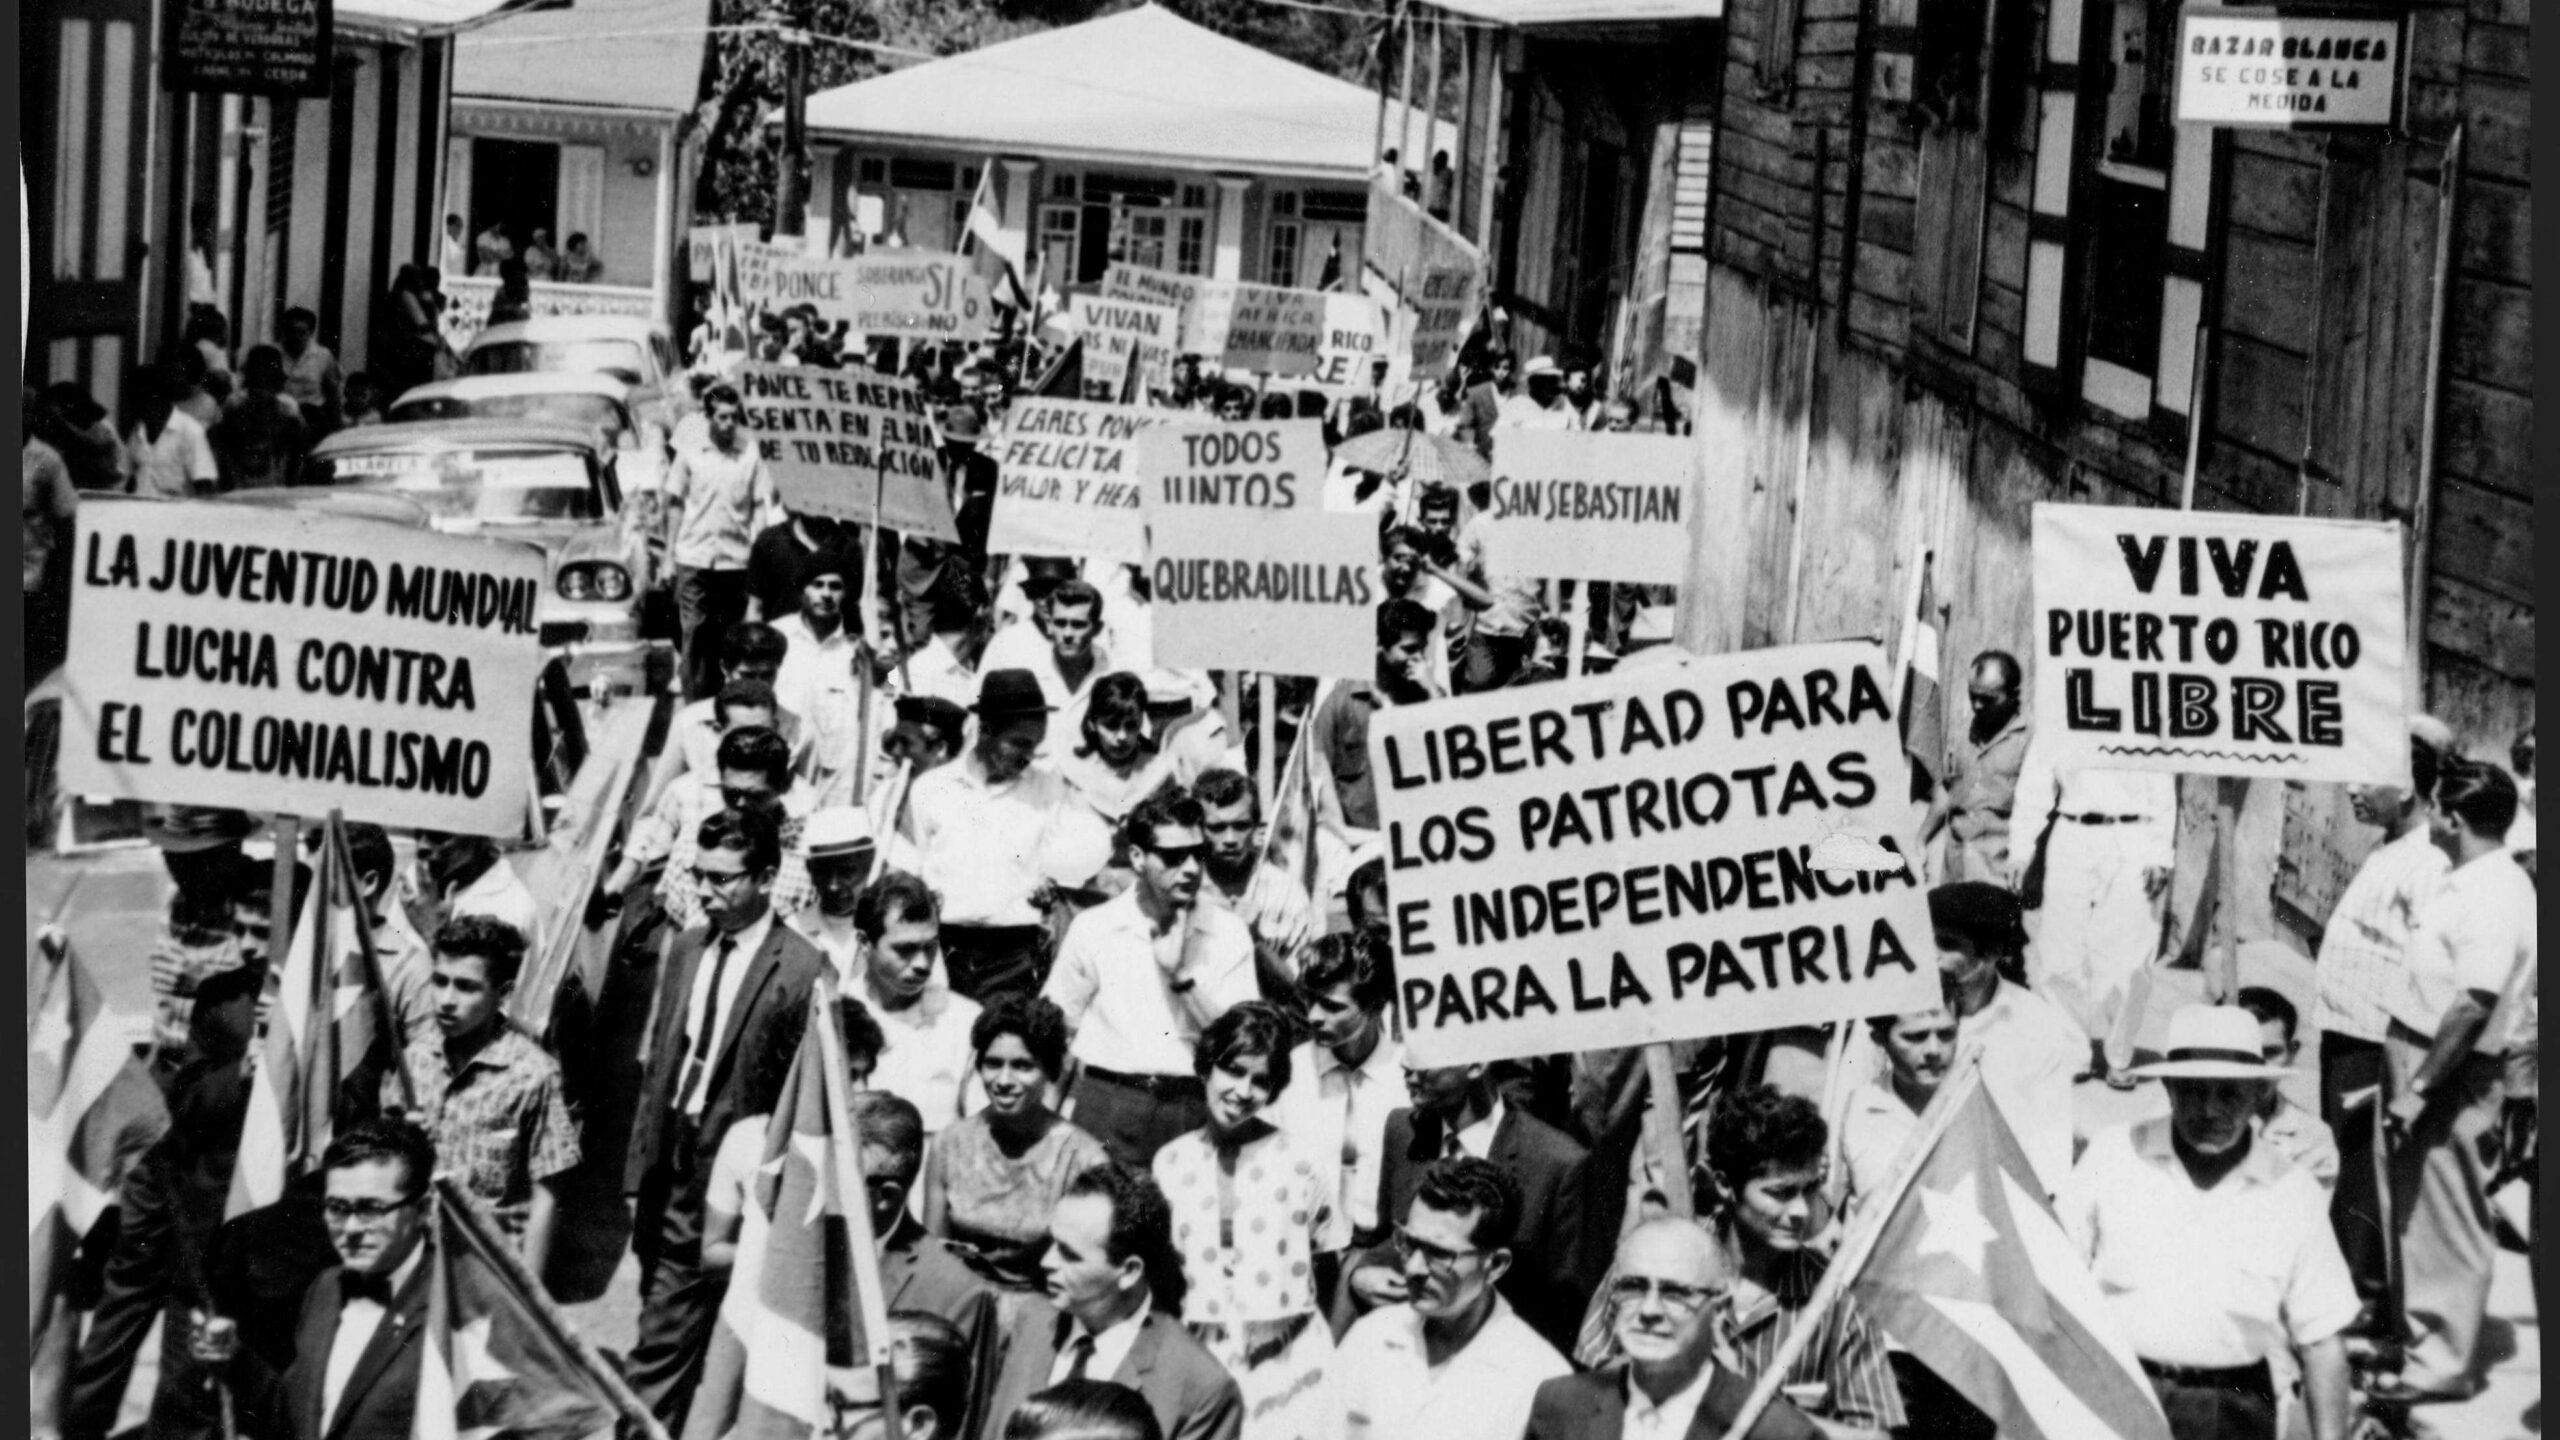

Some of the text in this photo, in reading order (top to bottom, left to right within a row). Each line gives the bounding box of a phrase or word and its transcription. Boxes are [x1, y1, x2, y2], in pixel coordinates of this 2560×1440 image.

[2191, 35, 2387, 61] BAZAR BLANCA
[2202, 66, 2359, 89] SE COSE A LA
[2249, 93, 2326, 113] MEDIDA
[775, 270, 841, 299] PONCE
[922, 262, 953, 311] SI
[1247, 289, 1304, 309] VIVA
[928, 313, 957, 332] NO
[1085, 303, 1161, 337] VIVAN
[1237, 307, 1315, 335] AFRICA
[1331, 330, 1372, 352] RICO
[744, 372, 811, 400] PONCE
[818, 378, 852, 404] TE
[747, 407, 834, 434] SENTA
[840, 411, 869, 438] EN
[1017, 407, 1090, 438] LARES
[758, 439, 782, 461] DE
[792, 440, 821, 464] TU
[1004, 439, 1123, 474] FELICITA
[1182, 430, 1281, 468] TODOS
[1002, 474, 1062, 501] VALOR
[1074, 479, 1090, 504] Y
[1493, 476, 1681, 524] SAN SEBASTIAN
[86, 531, 539, 636] LA JUVENTUD MUNDIAL
[1153, 556, 1372, 606] QUEBRADILLAS
[2116, 534, 2309, 602] VIVA
[2048, 608, 2361, 671] PUERTO RICO
[136, 621, 476, 712] LUCHA CONTRA
[2064, 667, 2344, 748] LIBRE
[1384, 663, 1892, 791] LIBERTAD PARA
[97, 701, 492, 800] EL COLONIALISMO
[1390, 750, 1878, 871] LOS PATRIOTAS
[1398, 834, 1918, 956] E INDEPENDENCIA
[1403, 917, 1917, 1030] PARA LA PATRIA
